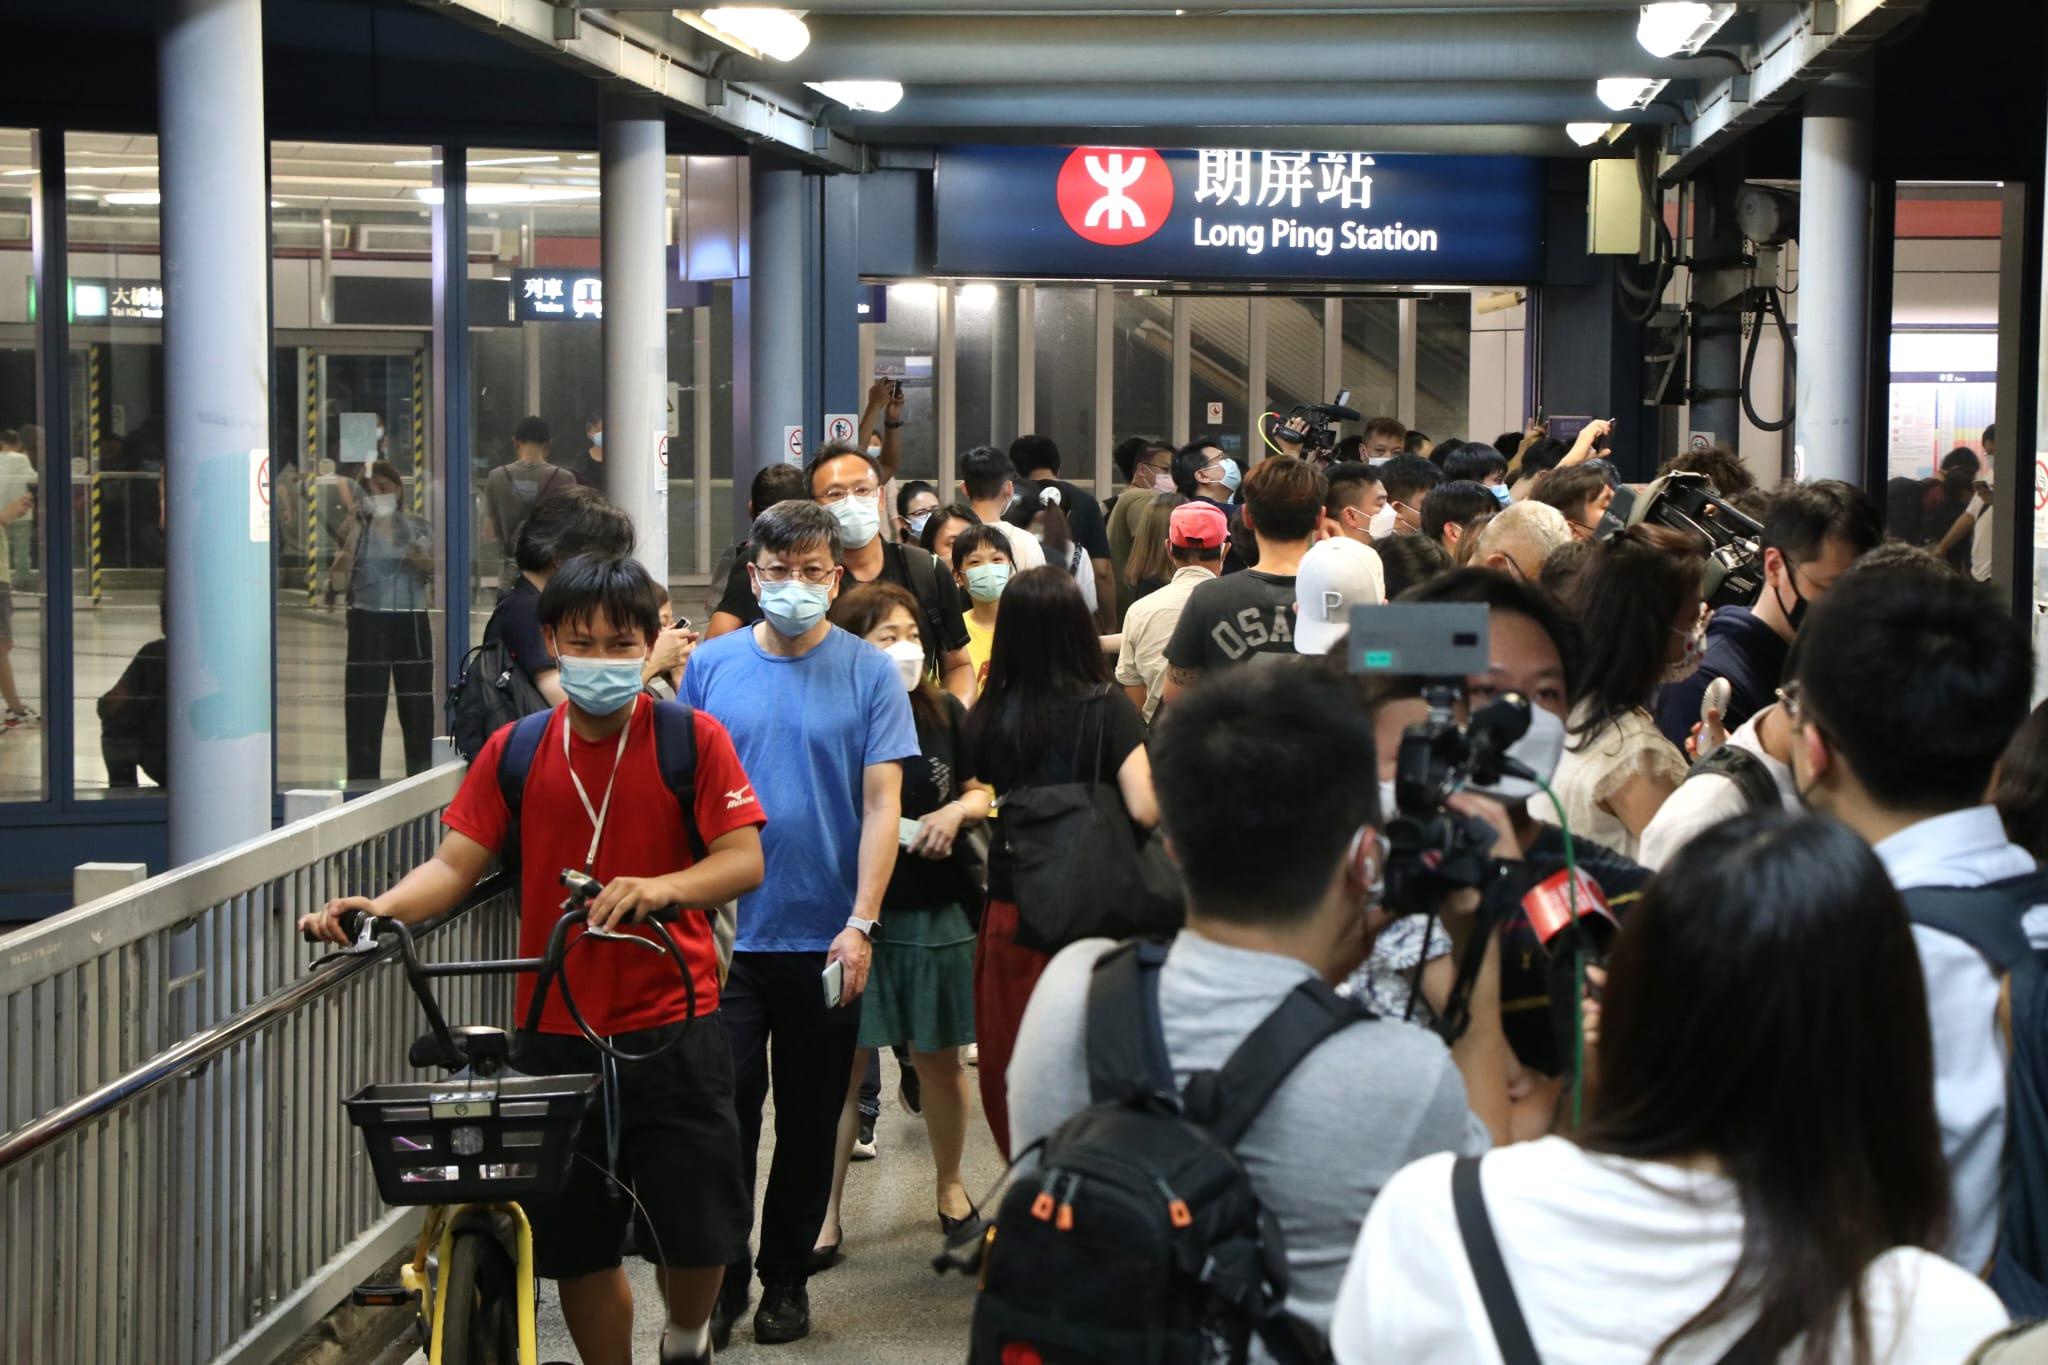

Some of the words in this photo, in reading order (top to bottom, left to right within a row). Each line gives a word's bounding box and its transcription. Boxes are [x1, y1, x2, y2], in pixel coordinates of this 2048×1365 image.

[1194, 150, 1375, 209] 朗屏站
[1194, 217, 1265, 254] Long
[1271, 218, 1334, 256] Ping
[1340, 221, 1438, 251] Station
[1322, 591, 1343, 620] P
